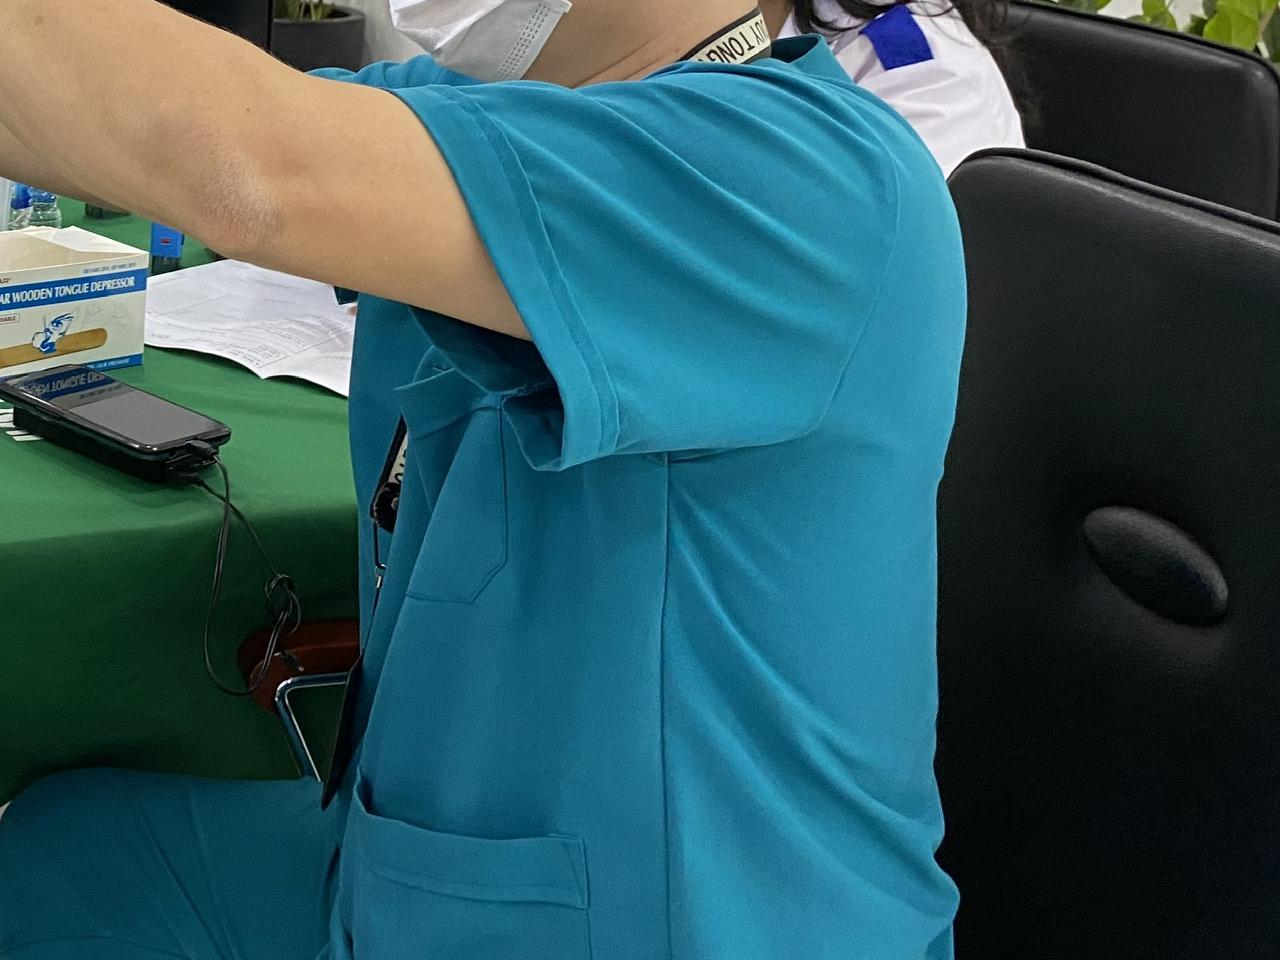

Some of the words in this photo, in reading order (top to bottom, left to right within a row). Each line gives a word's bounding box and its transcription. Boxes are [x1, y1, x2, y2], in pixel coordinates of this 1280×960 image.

[12, 288, 53, 304] WOODEN
[55, 282, 89, 297] TONGUE
[90, 276, 135, 293] DEPRESSOR
